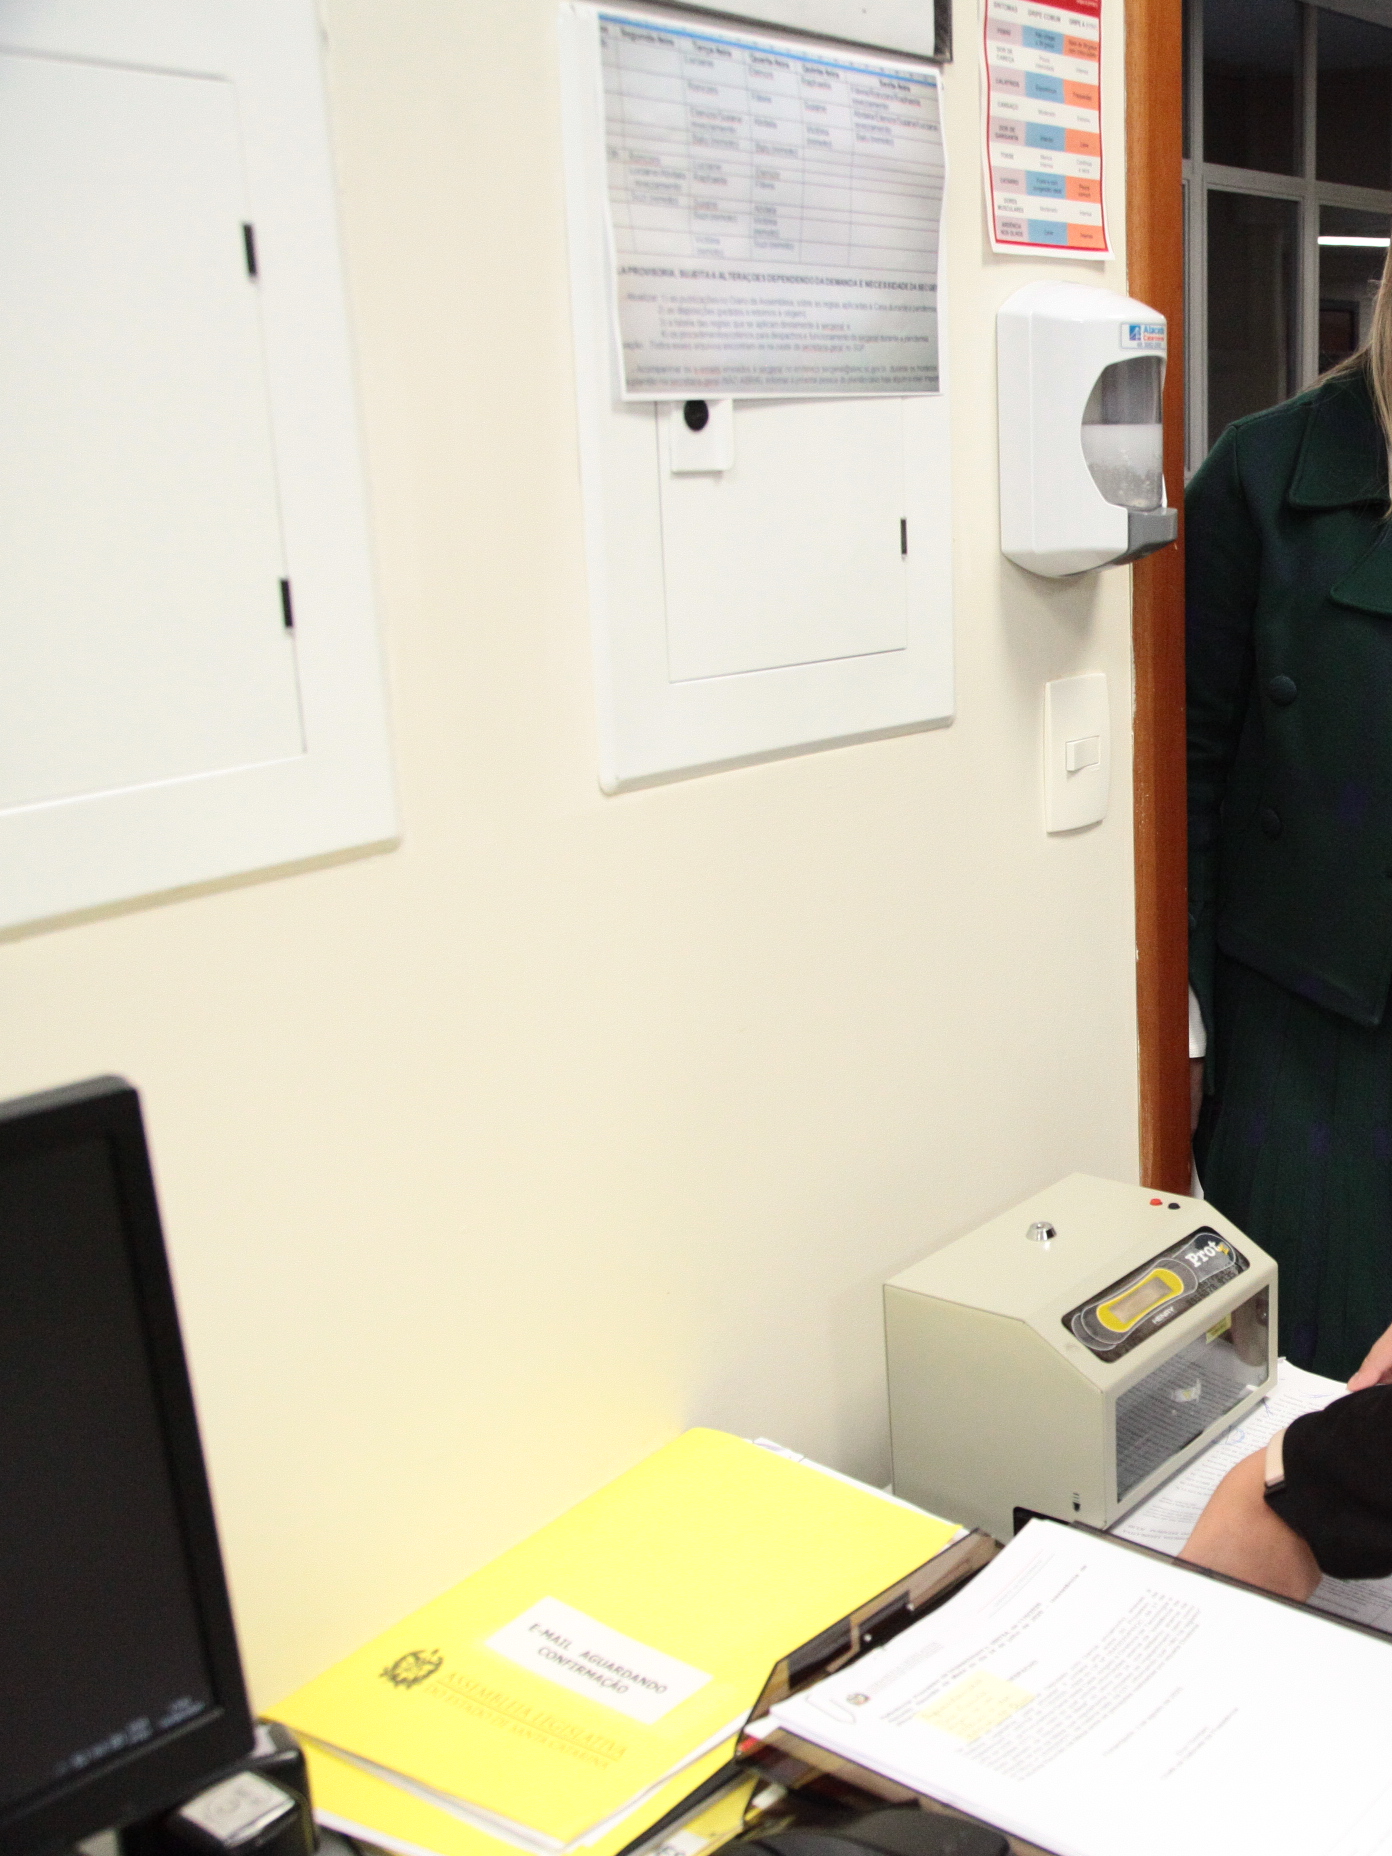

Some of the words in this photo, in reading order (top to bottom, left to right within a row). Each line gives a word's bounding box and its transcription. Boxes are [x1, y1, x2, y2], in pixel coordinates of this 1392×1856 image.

[1152, 1306, 1175, 1325] HENRY
[528, 1623, 573, 1651] E-MAIL
[579, 1650, 667, 1695] AGUARDANDO
[537, 1646, 630, 1696] CONFIRMAÇÃO
